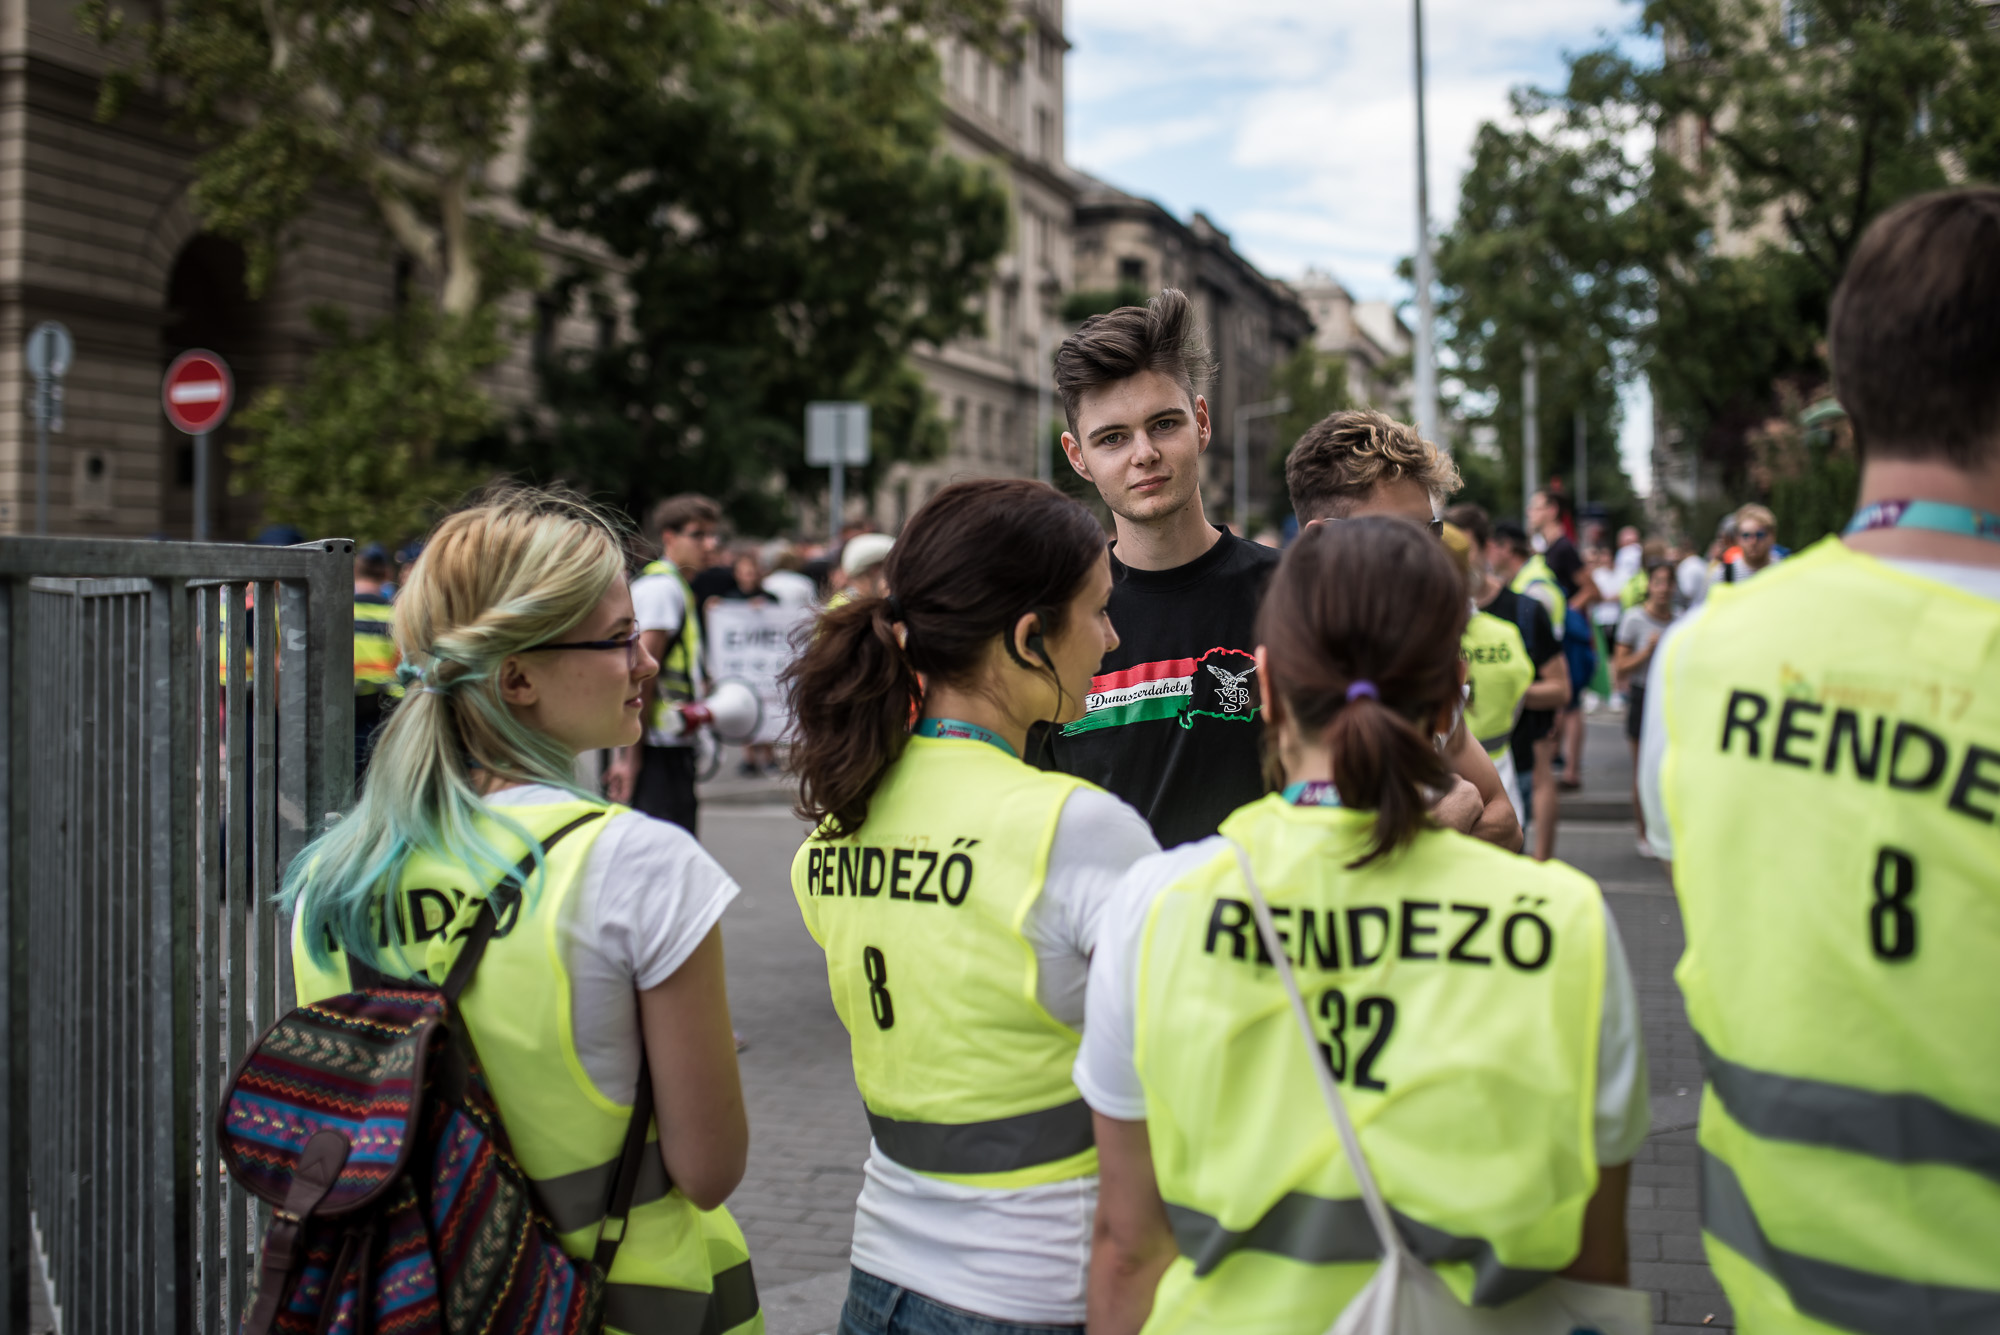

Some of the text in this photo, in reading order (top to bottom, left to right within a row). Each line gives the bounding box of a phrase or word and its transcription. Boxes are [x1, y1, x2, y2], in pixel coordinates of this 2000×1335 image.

[1090, 681, 1189, 709] Dunaszerdahely
[807, 837, 981, 907] RENDEZŐ
[1871, 844, 1918, 965] 8
[1204, 894, 1554, 972] RENDEZŐ
[863, 945, 895, 1031] 8
[1317, 987, 1397, 1093] 32
